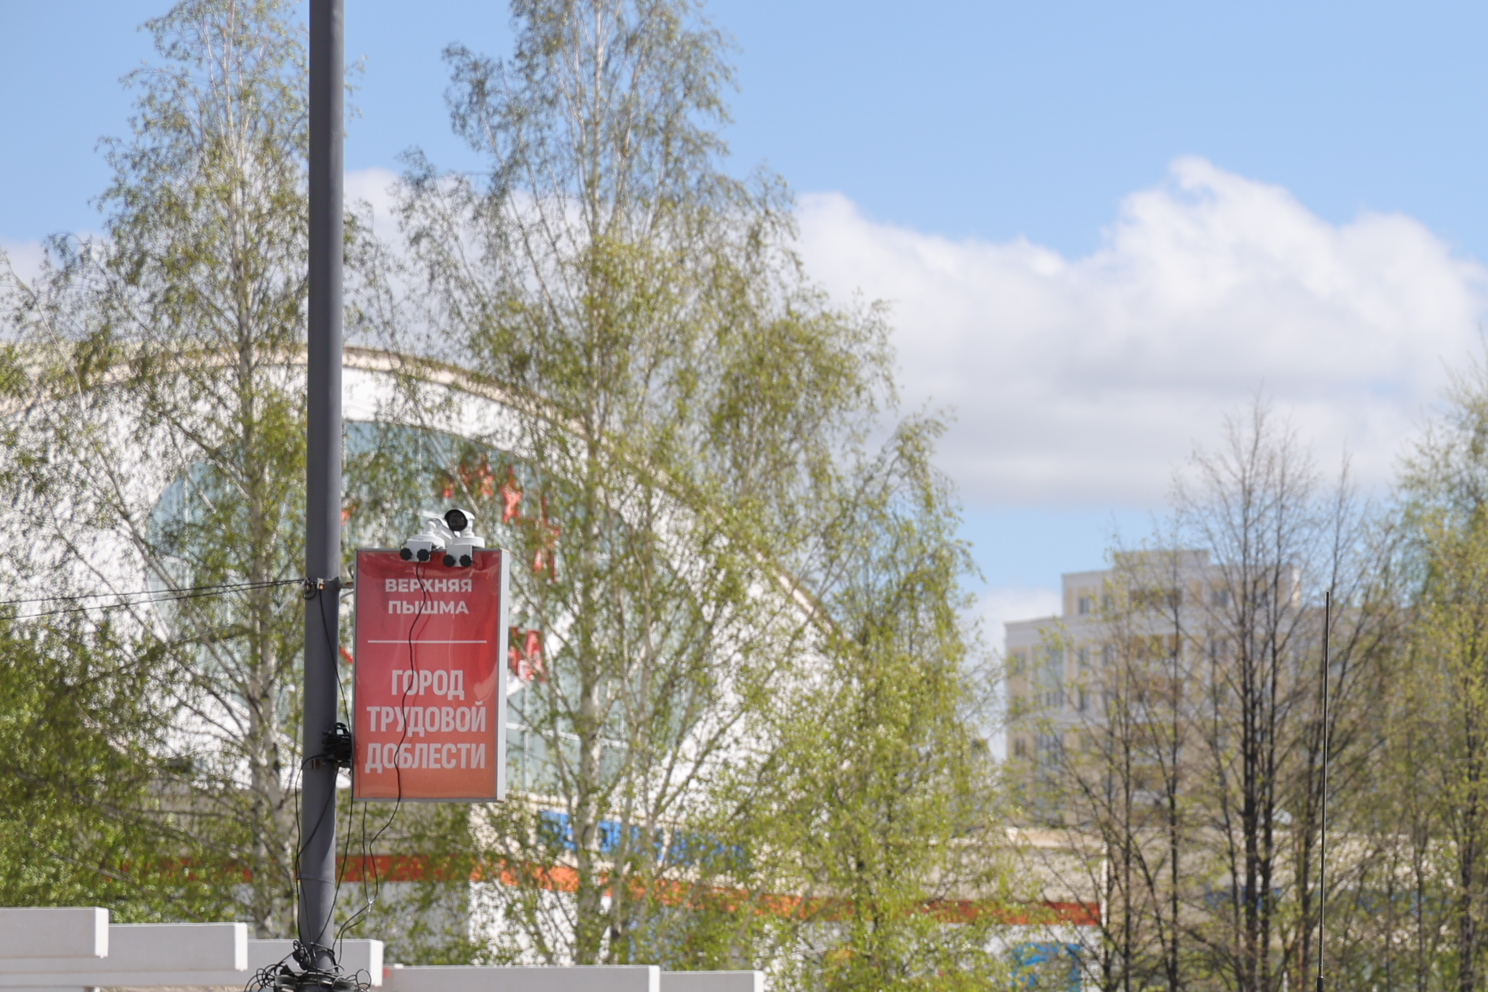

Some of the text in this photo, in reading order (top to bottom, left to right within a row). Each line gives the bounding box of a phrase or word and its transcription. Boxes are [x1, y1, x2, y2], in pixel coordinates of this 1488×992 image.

[385, 578, 472, 593] ВЕРХНЯЯ
[388, 600, 469, 615] ПЫШМА
[391, 669, 464, 700] ГОРОД
[366, 702, 486, 737] ТРУДОВОЙ
[365, 743, 486, 774] ДОБЛЕСТИ
